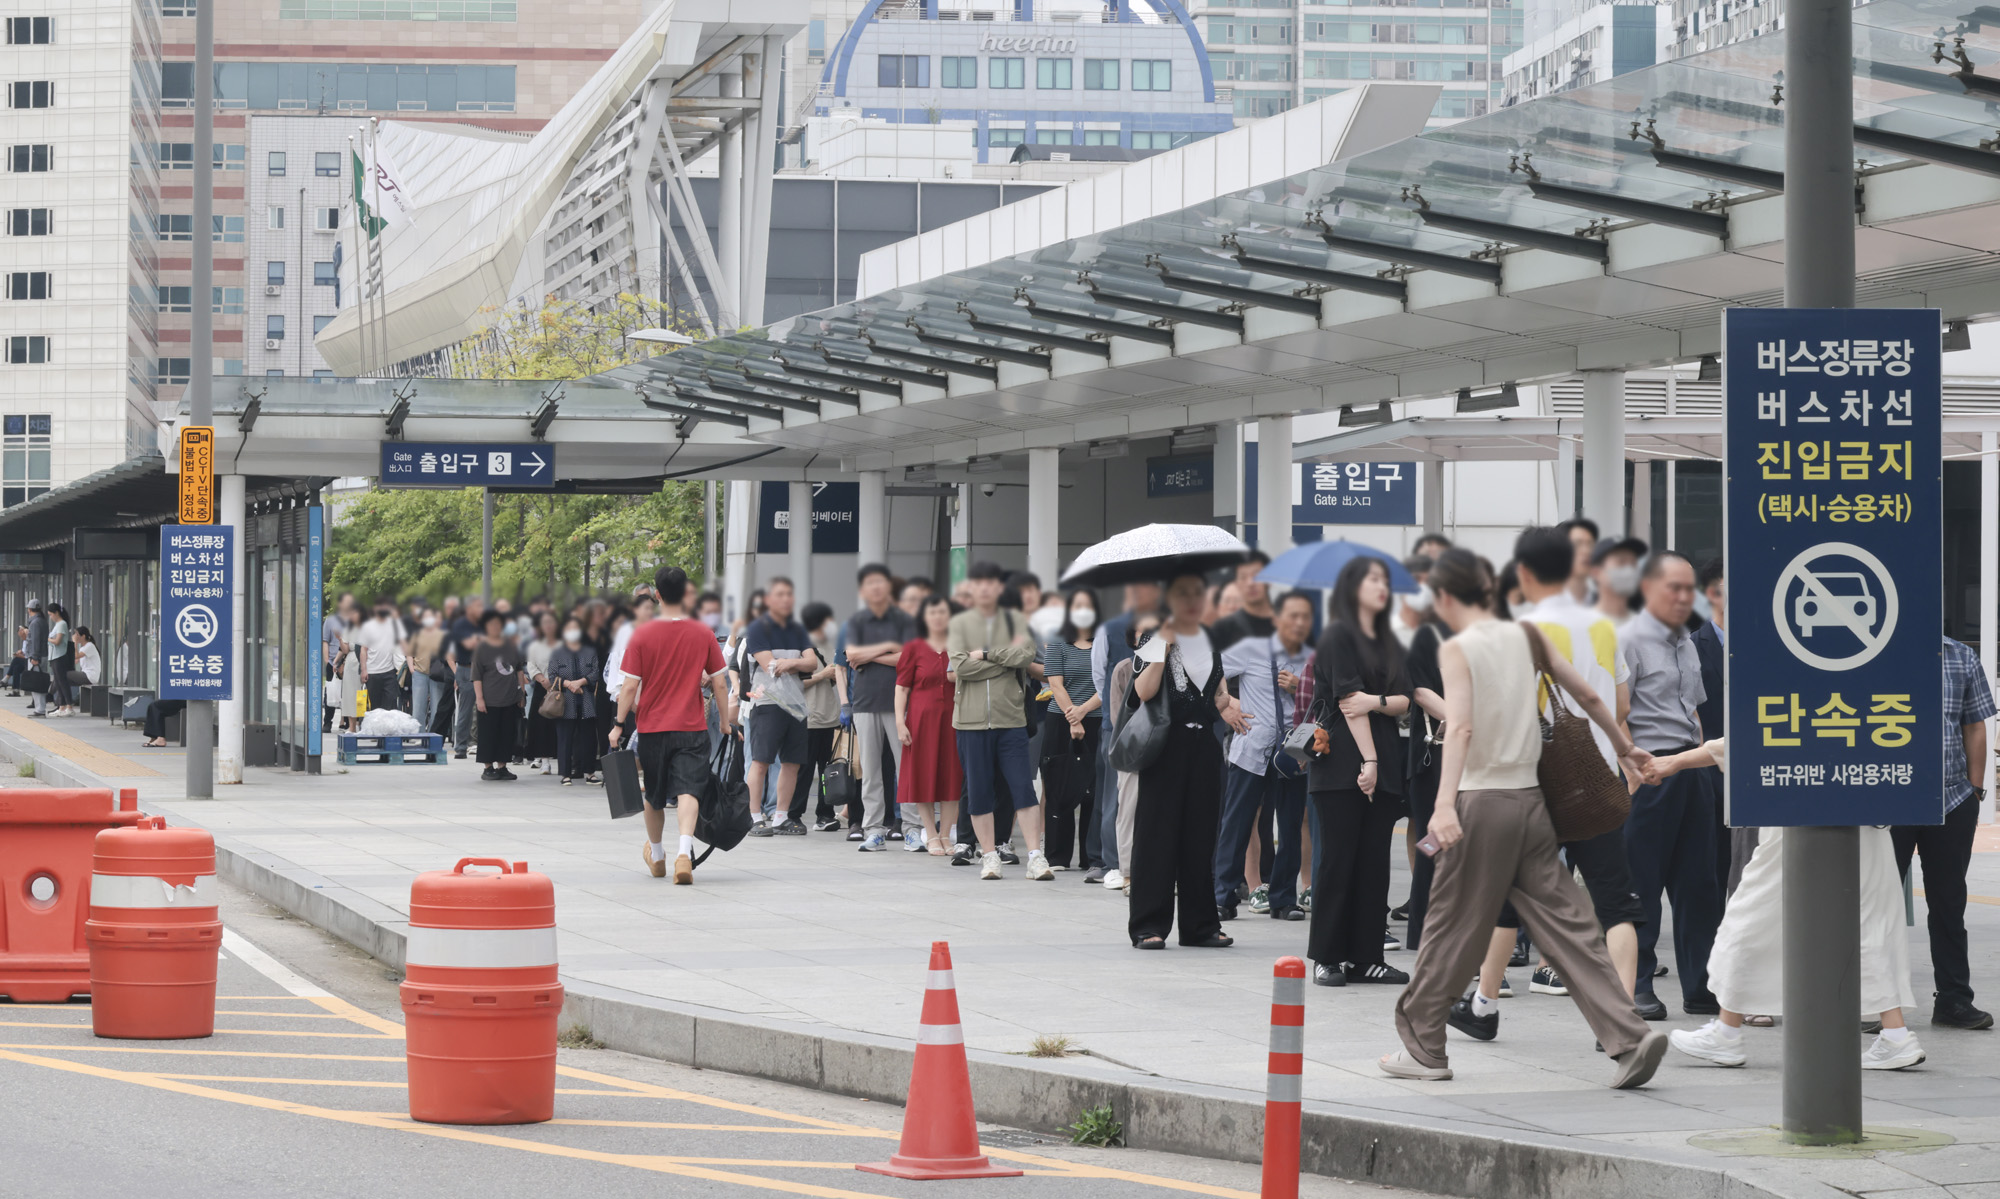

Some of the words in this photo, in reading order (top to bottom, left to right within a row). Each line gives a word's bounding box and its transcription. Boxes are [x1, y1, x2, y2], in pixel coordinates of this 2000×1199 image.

[980, 29, 1078, 53] heerim
[1757, 339, 1915, 377] 버스정류장
[184, 447, 196, 472] 불법
[393, 452, 412, 462] Gate
[419, 452, 479, 474] 출입구
[494, 455, 505, 473] 3
[1756, 440, 1913, 480] 진입금지
[388, 464, 412, 473] 出入口
[1312, 463, 1403, 492] 출입구
[1314, 493, 1337, 506] Gate
[1342, 495, 1371, 507] 出入口
[1758, 493, 1912, 524] (택시·승용차)
[812, 510, 853, 523] 리베이터
[171, 535, 226, 549] 버스정류장
[170, 569, 224, 584] 진입금지
[170, 587, 224, 599] (택시·승용차)
[169, 654, 224, 674] 단속중
[170, 678, 193, 687] 법규위반
[1757, 692, 1917, 748] 단속중
[1760, 764, 1826, 787] 법규위반
[1831, 763, 1914, 786] 사업용차량
